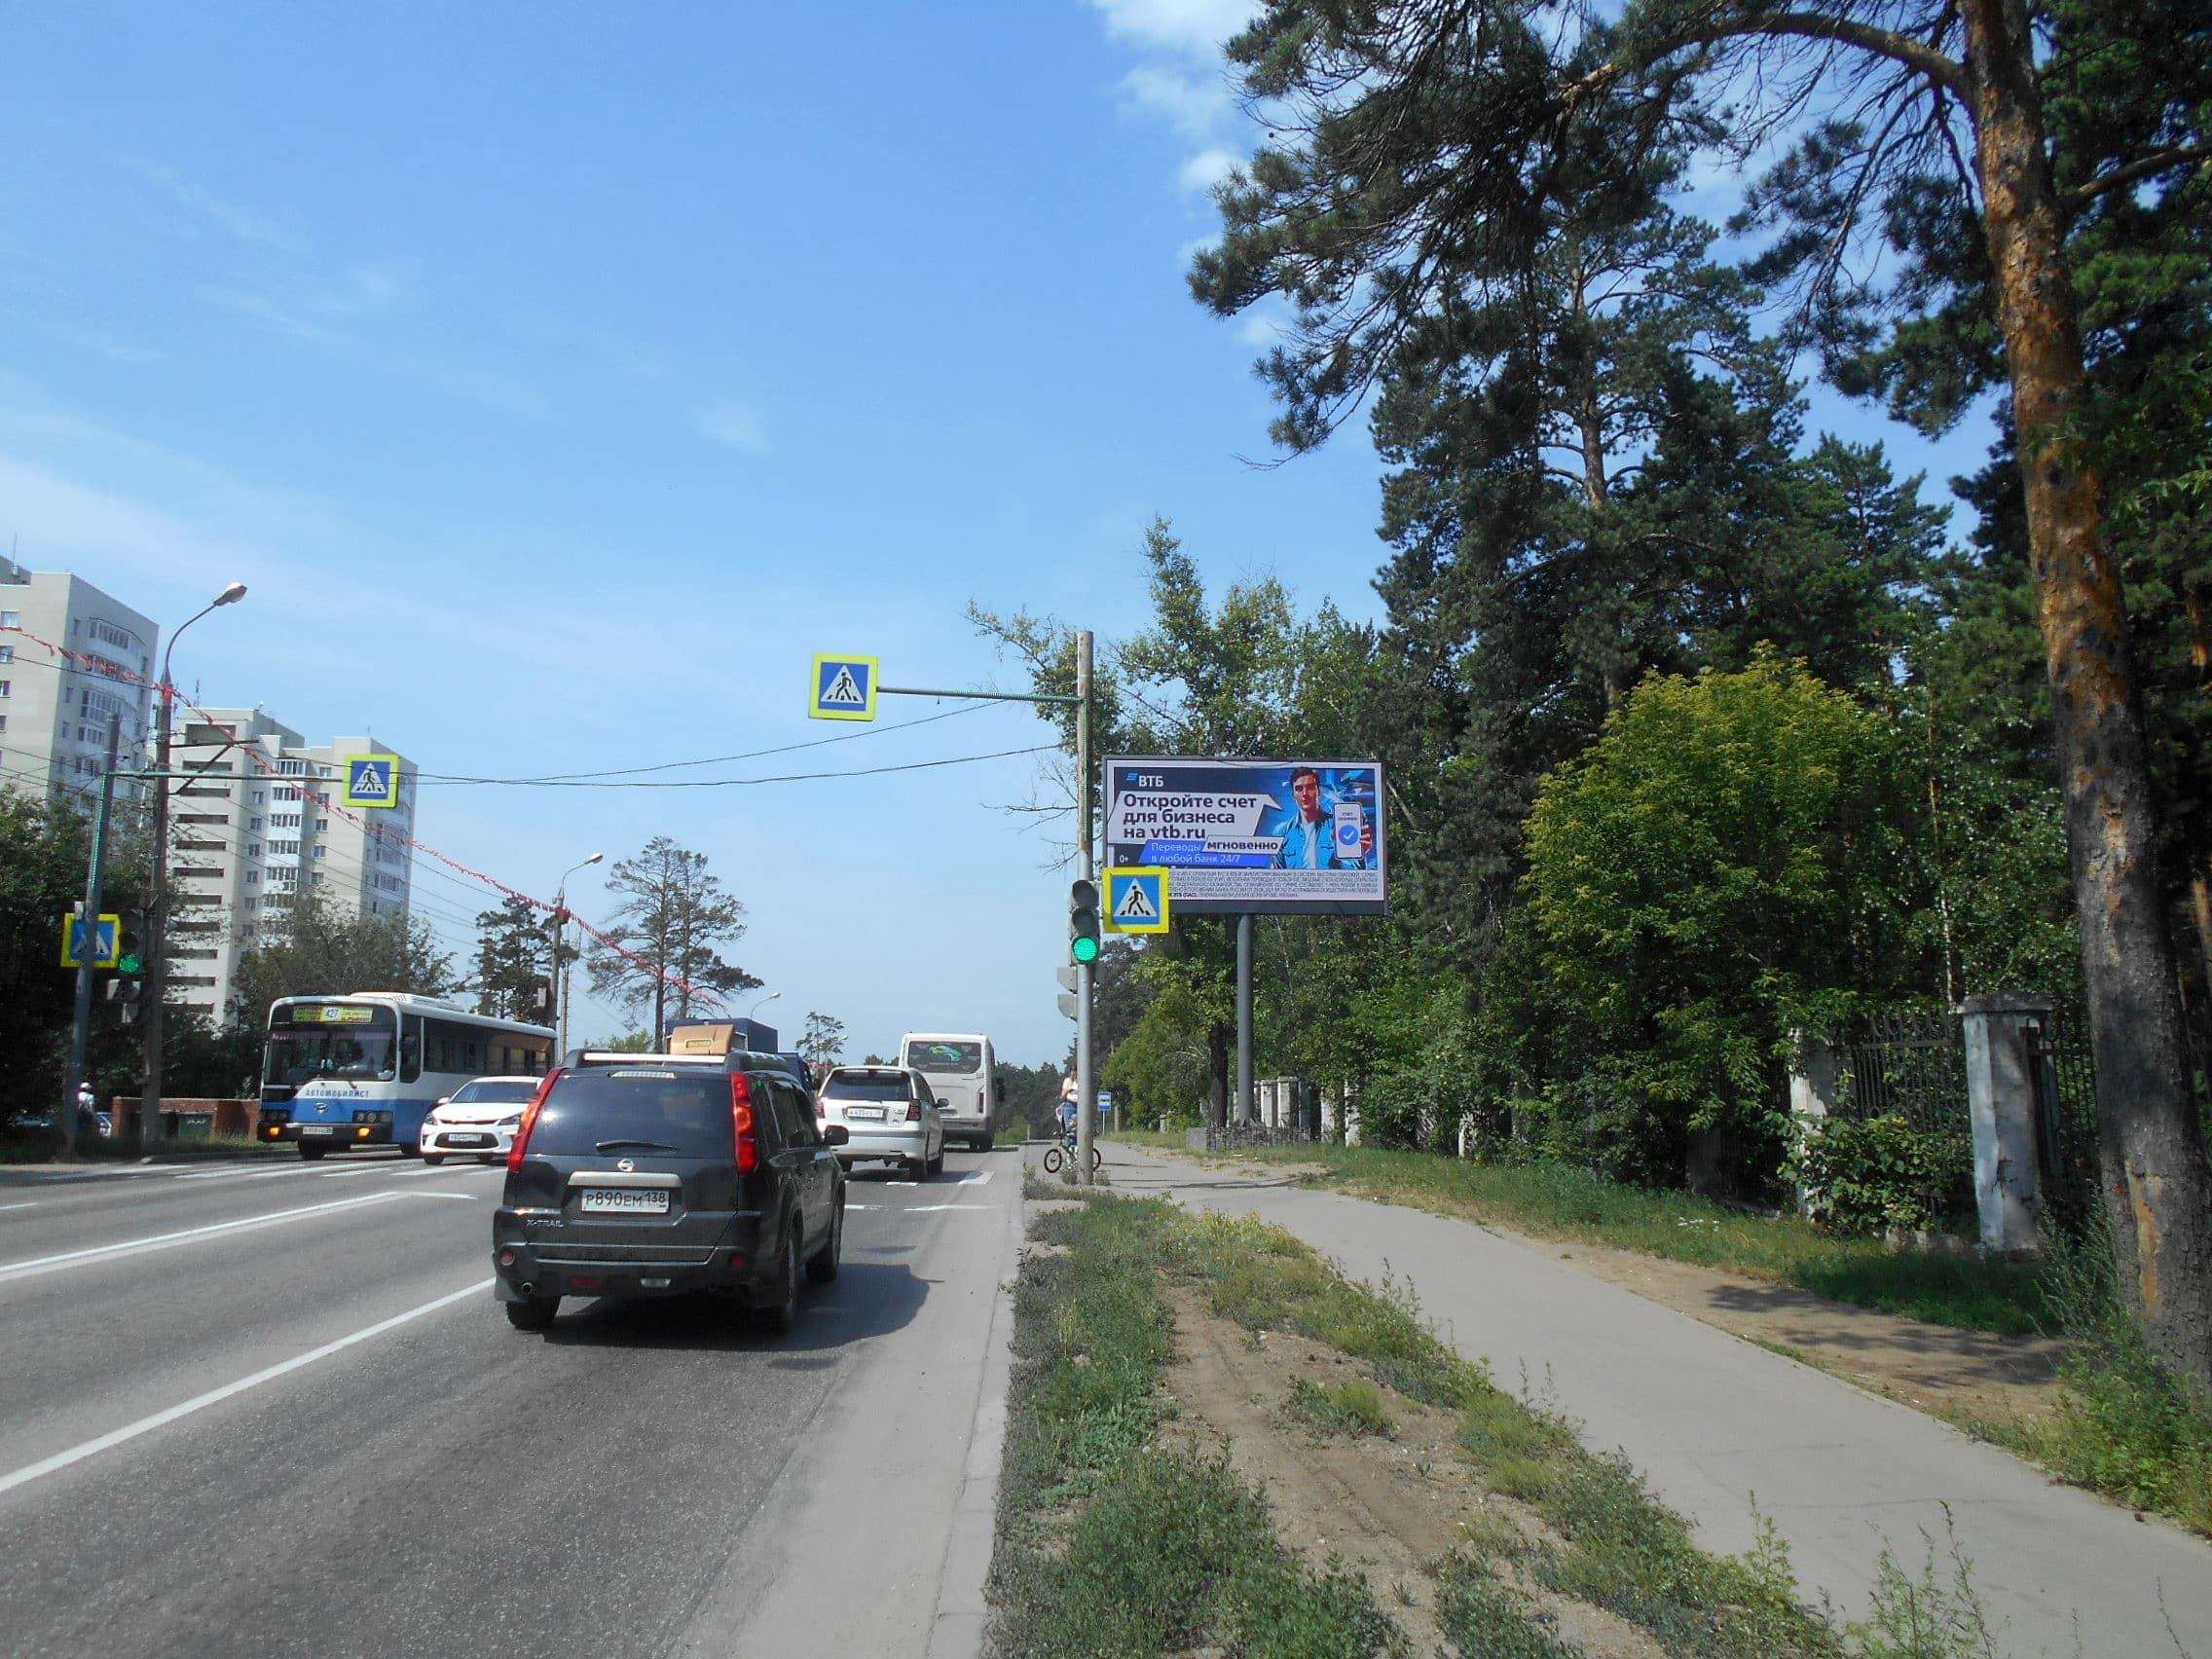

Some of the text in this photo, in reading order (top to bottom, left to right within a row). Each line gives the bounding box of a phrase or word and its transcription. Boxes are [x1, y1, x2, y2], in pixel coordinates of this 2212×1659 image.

[1138, 775, 1164, 788] ВТБ
[1124, 793, 1258, 811] Откройте счет
[1123, 808, 1235, 826] для бизнеса
[1124, 825, 1206, 839] на vtb.ru
[1151, 841, 1278, 853] Переводы мгновенно
[1120, 854, 1129, 864] 0+
[1160, 853, 1193, 864] любой
[1194, 854, 1218, 864] банк
[1220, 854, 1241, 864] 24/7
[305, 1089, 369, 1098] АВТОМОБИЛИСТ
[586, 1191, 667, 1207] Р890ЕМ 138
[527, 1219, 565, 1228] X-TRAIL
